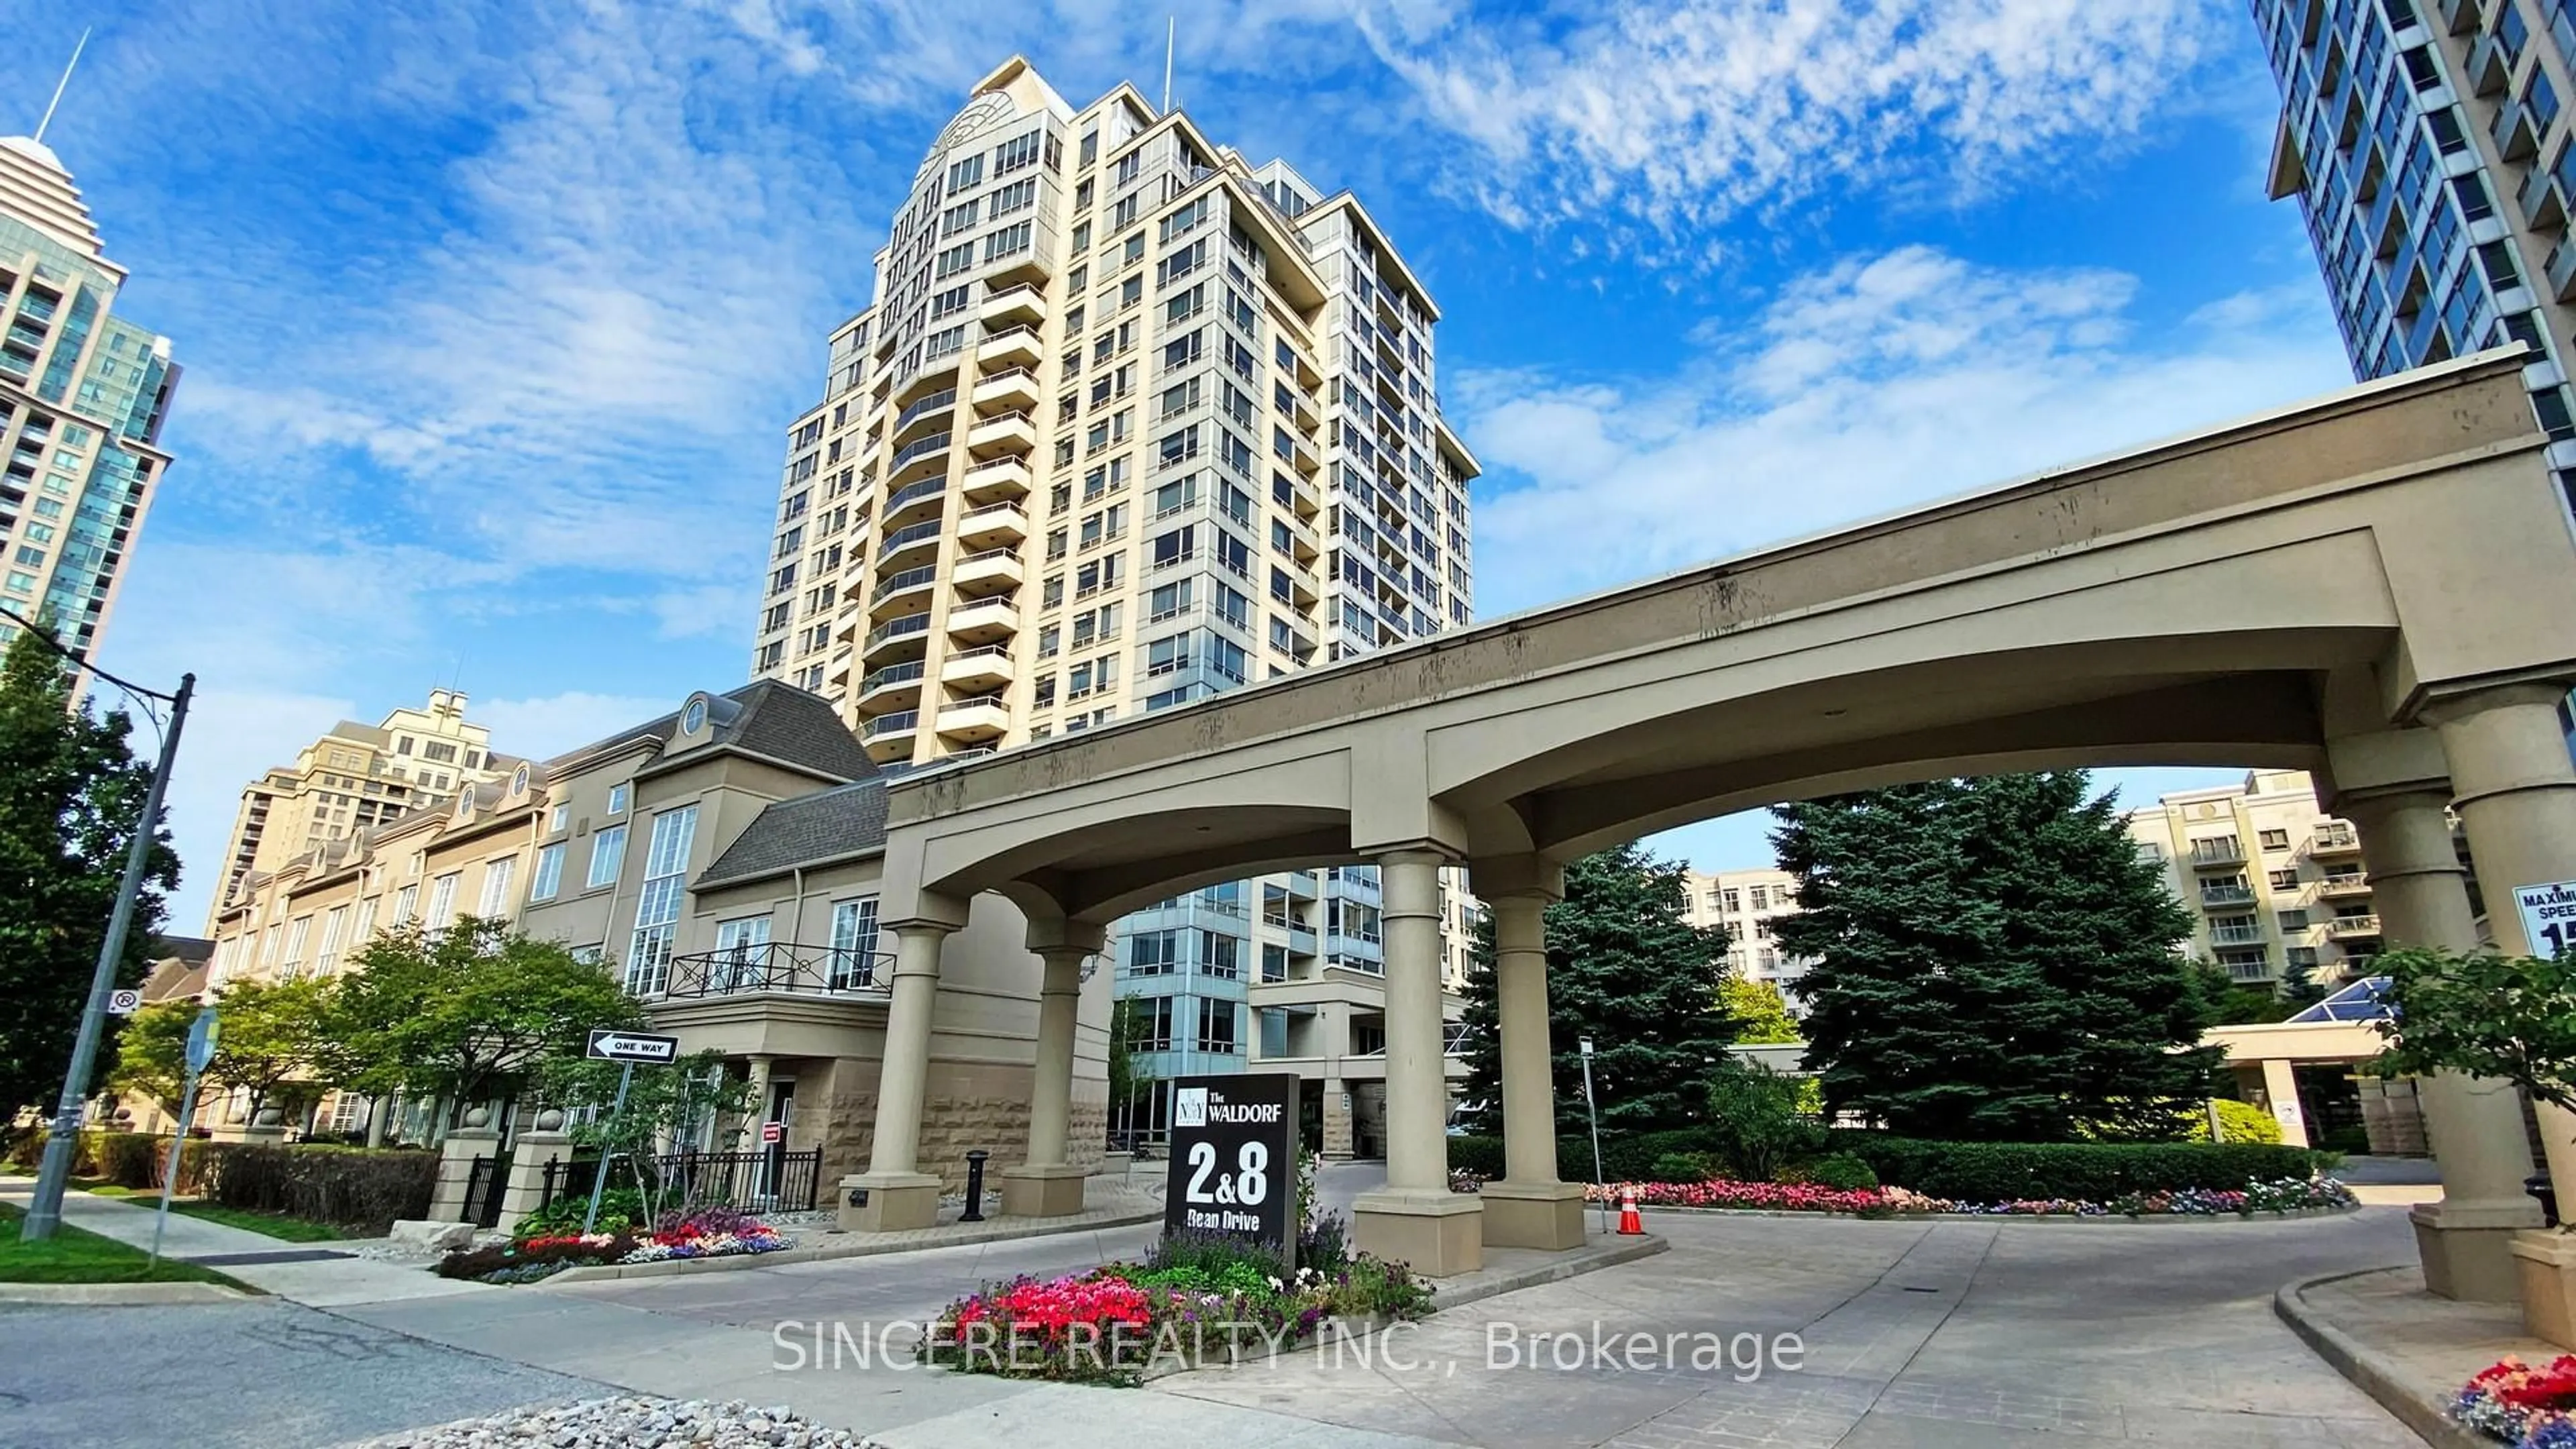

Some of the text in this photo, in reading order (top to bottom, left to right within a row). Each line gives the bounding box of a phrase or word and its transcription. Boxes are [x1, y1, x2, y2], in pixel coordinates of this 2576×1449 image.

[2539, 905, 2576, 919] SPEE
[614, 1042, 663, 1053] ONE WAY
[1210, 1092, 1224, 1104] The
[1209, 1104, 1282, 1123] WALDORF
[1187, 1208, 1260, 1232] Rean Drive
